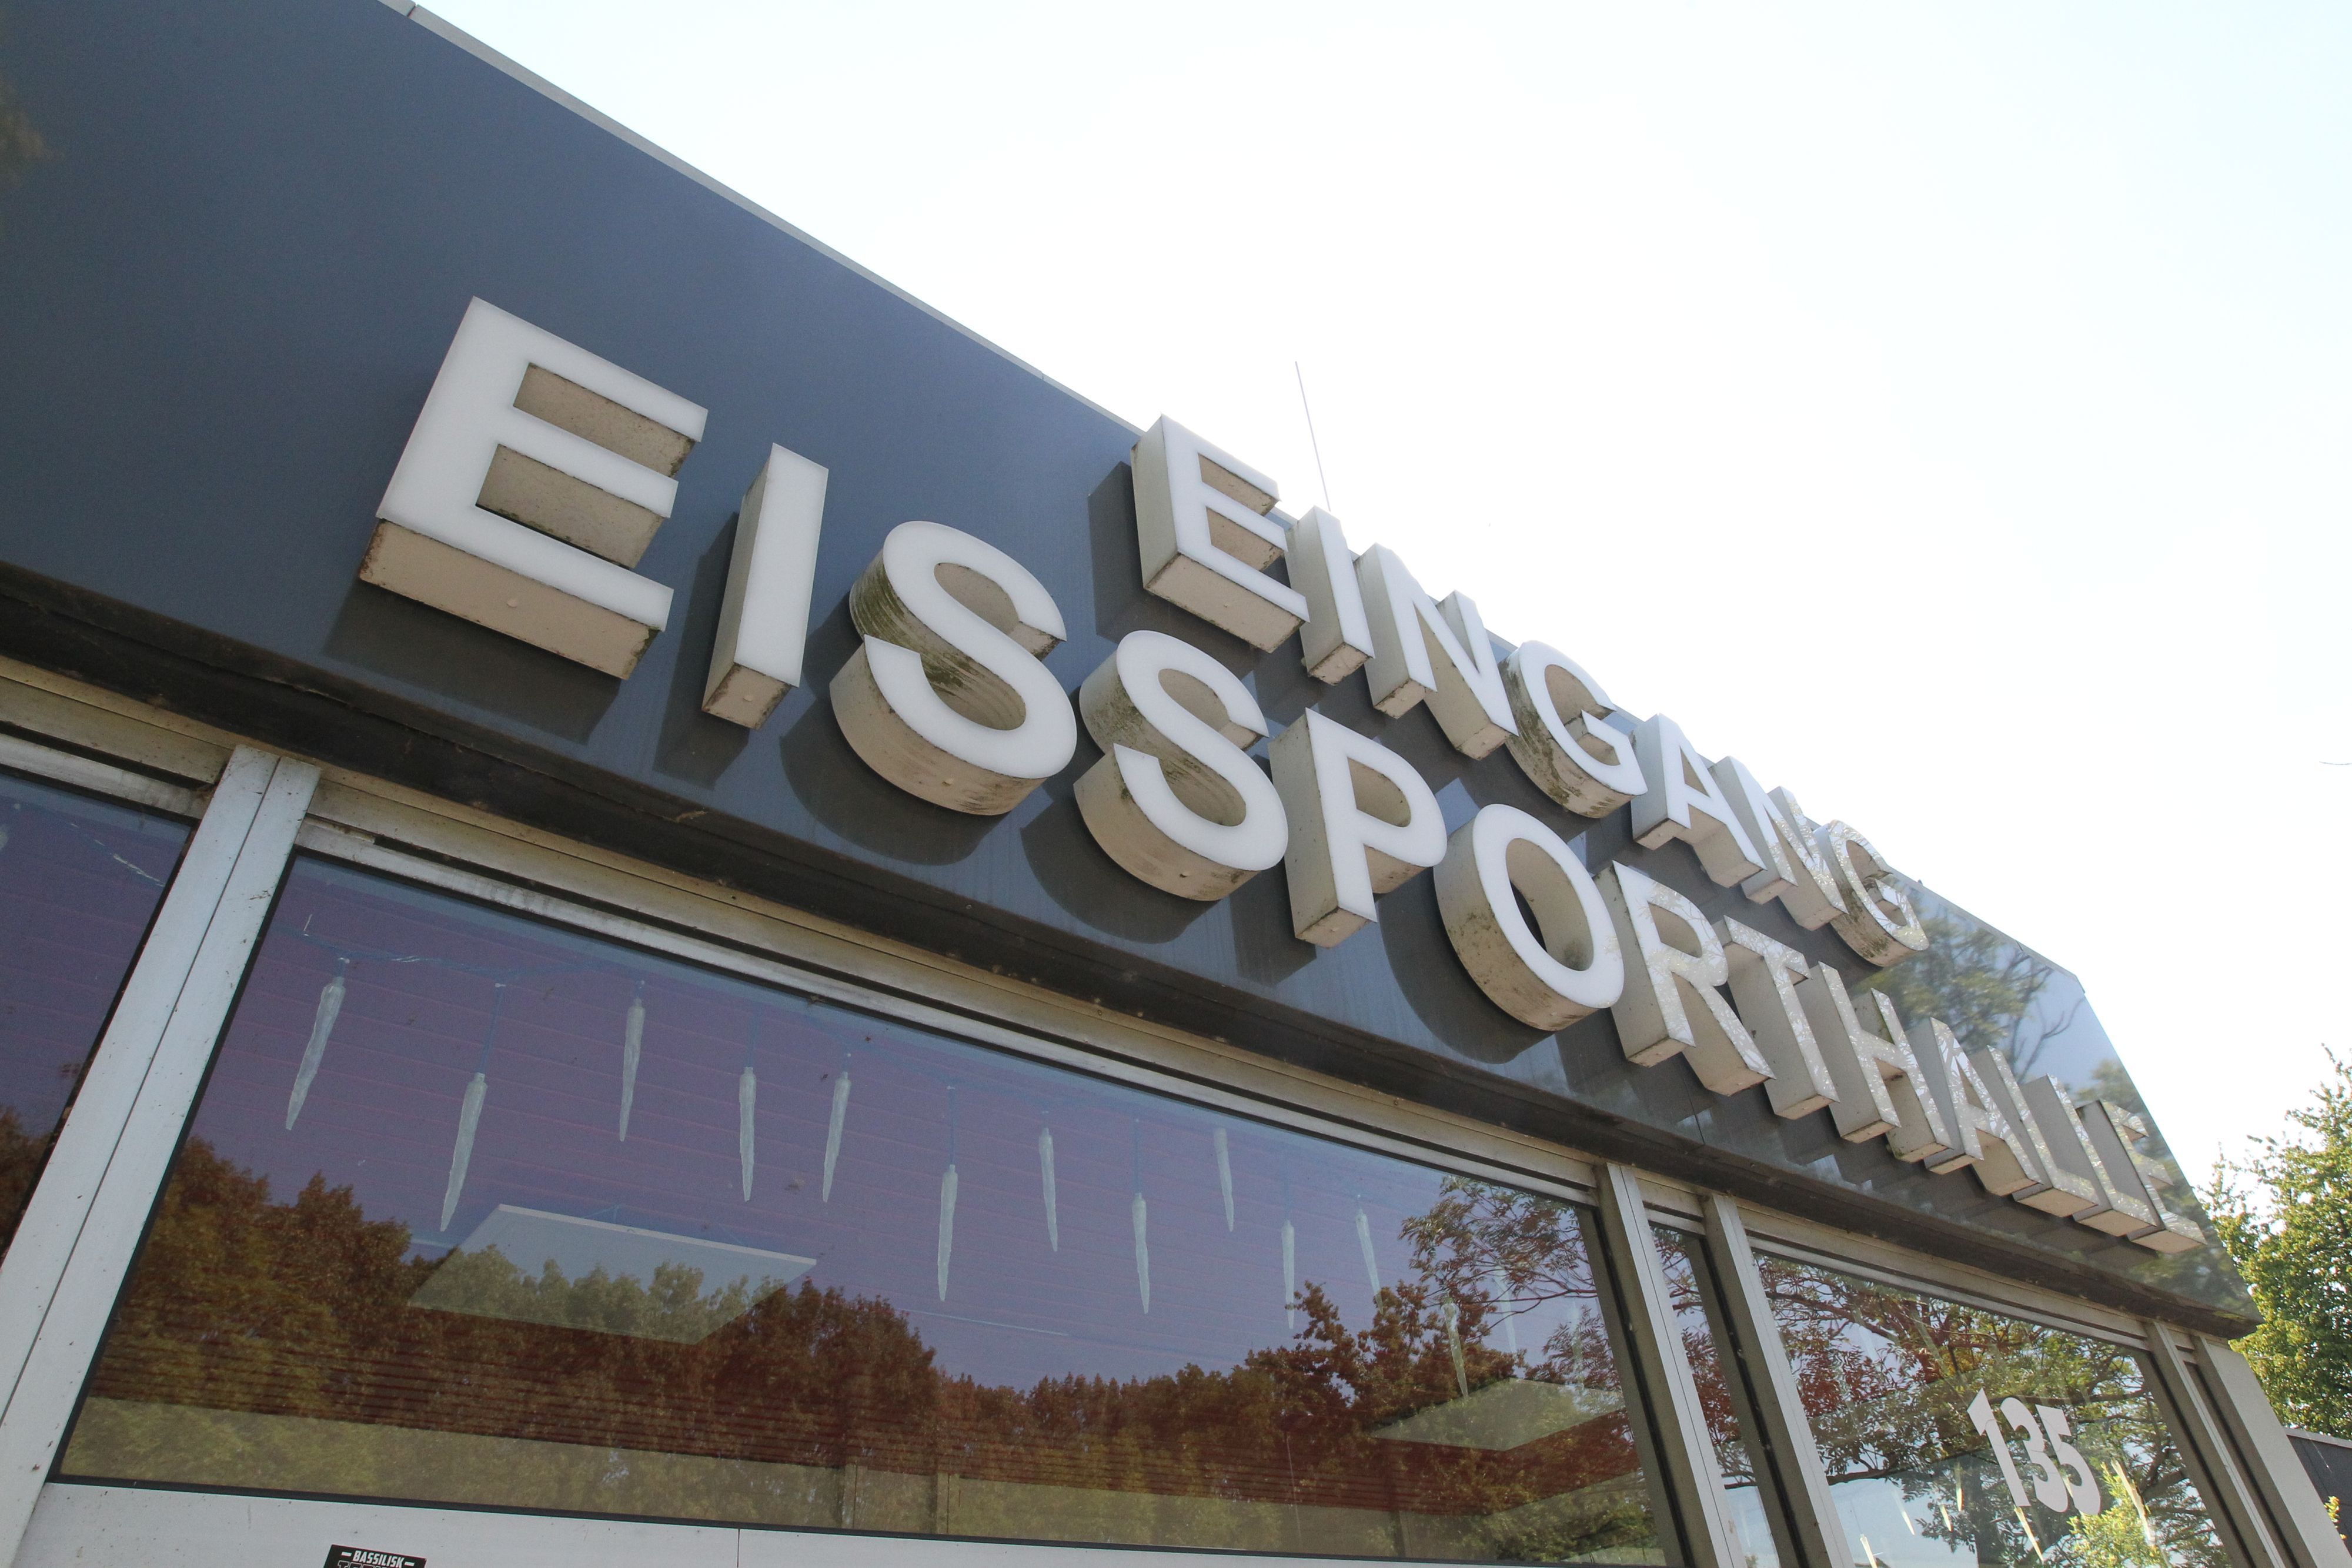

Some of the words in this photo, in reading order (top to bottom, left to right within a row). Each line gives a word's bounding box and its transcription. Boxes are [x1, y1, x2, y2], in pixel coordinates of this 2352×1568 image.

[376, 296, 2206, 1245] EISSPORTHALLE
[1161, 413, 1930, 951] EINGANG
[353, 1550, 405, 1568] BASSILISK
[1967, 1388, 2102, 1516] 135
